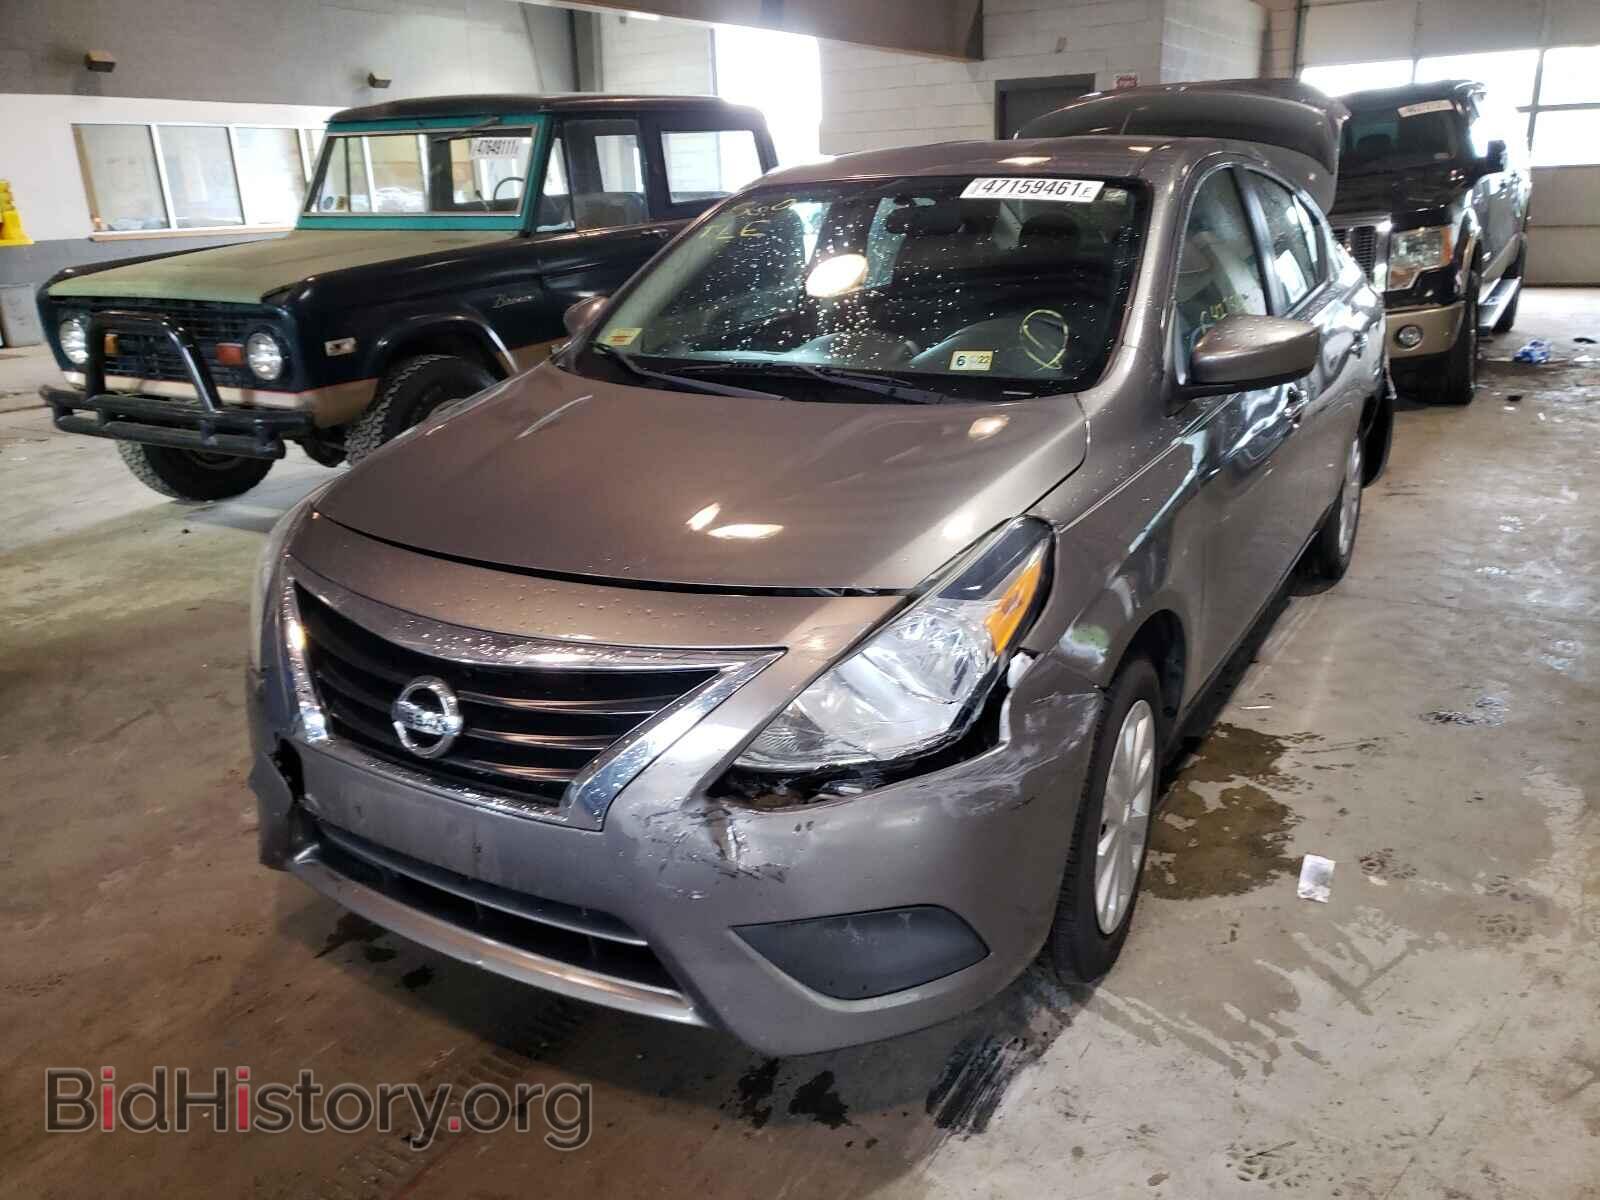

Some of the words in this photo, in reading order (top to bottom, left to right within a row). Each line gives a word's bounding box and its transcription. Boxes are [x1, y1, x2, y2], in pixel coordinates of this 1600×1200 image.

[982, 179, 1082, 196] 47159461
[956, 355, 967, 367] 6
[976, 354, 991, 365] 22
